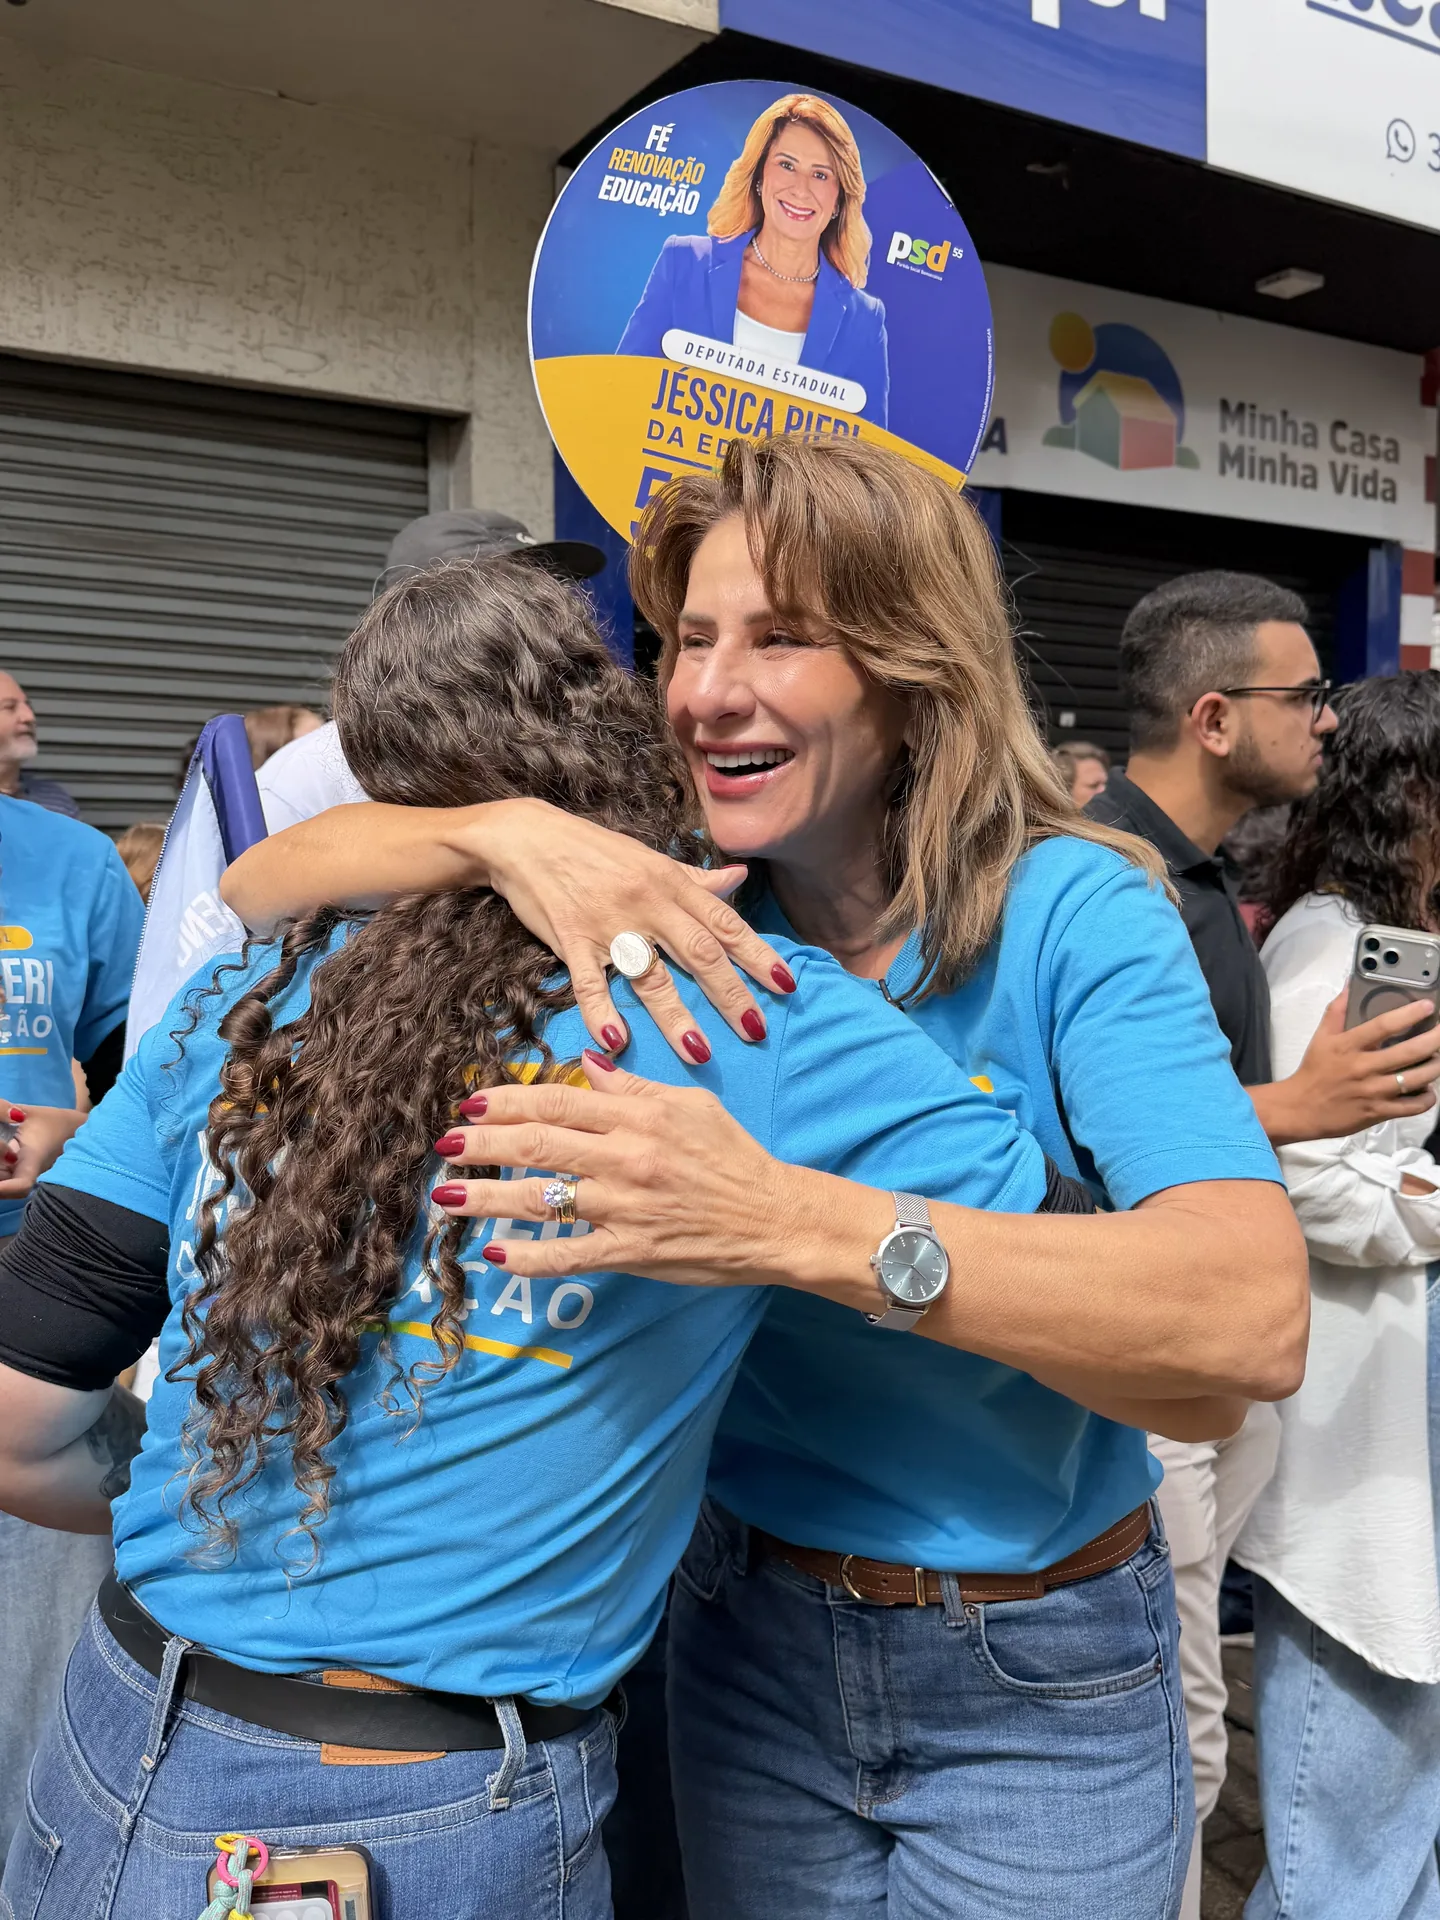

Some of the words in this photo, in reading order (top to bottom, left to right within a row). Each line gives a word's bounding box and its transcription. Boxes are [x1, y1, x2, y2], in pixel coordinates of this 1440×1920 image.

[645, 123, 676, 152] FÉ
[608, 147, 706, 186] RENOVAÇÃO
[598, 175, 700, 216] EDUCAÇÃO
[886, 231, 951, 272] psd
[684, 342, 765, 377] DEPUTADA
[772, 367, 846, 401] ESTADUAL
[652, 367, 774, 437] JÉSSICA
[647, 419, 684, 448] DA
[1219, 398, 1318, 450] Minha
[1329, 420, 1399, 464] Casa
[1219, 442, 1317, 491] Minha
[1328, 460, 1397, 504] Vida
